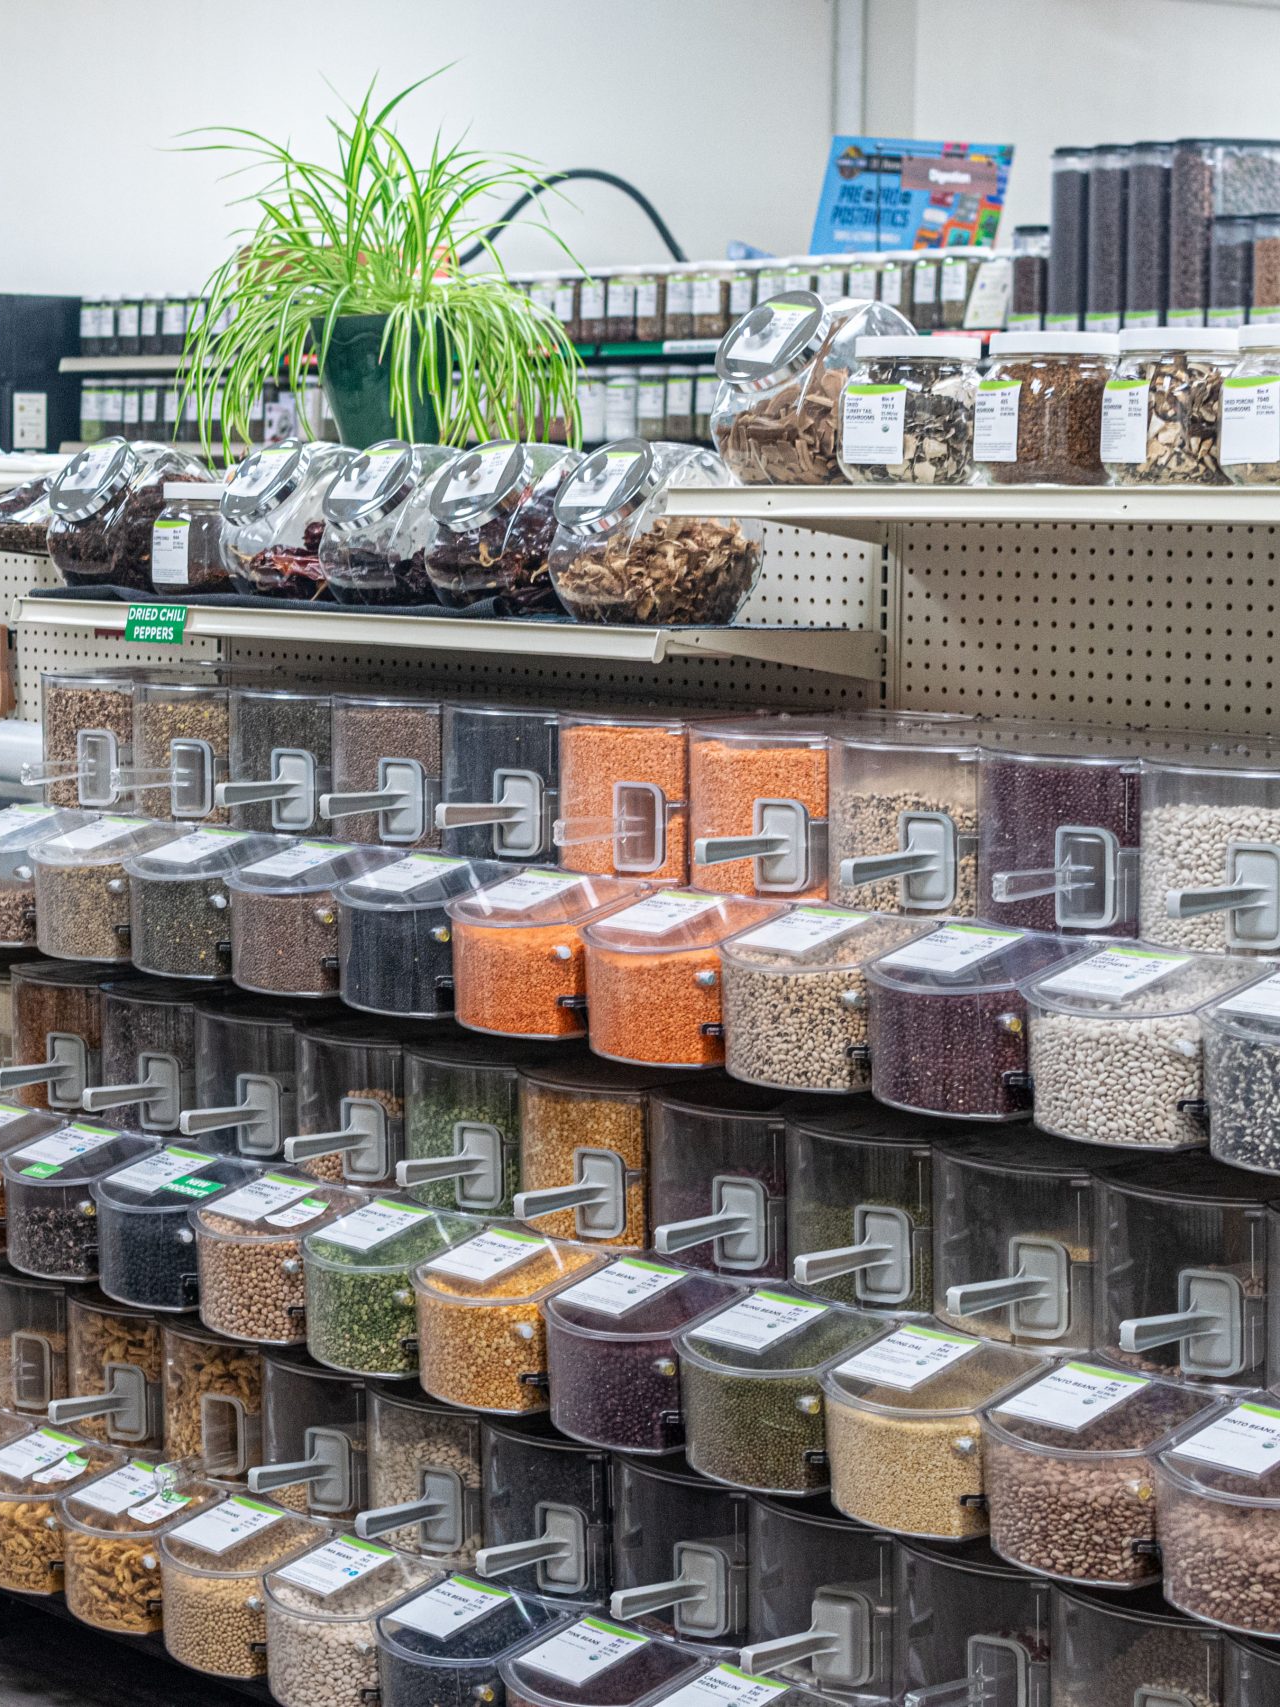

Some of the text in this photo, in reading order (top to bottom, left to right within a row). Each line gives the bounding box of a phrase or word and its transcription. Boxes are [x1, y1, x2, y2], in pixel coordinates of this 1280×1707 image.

[129, 608, 186, 622] DRIED CHILI
[134, 626, 174, 641] PEPPERS
[163, 1182, 210, 1197] PRODUCT
[186, 1178, 212, 1188] NEW
[617, 1273, 636, 1281] BEANS
[741, 1303, 761, 1312] MUNG
[761, 1307, 782, 1317] BEANS
[887, 1338, 907, 1347] MUNG
[908, 1343, 923, 1351] DAL
[1048, 1376, 1072, 1385] PINTO
[1072, 1381, 1098, 1391] BEANS
[1223, 1417, 1276, 1434] PINTO BEANS
[336, 1552, 353, 1560] BEANS
[435, 1588, 451, 1597] BLACK
[451, 1594, 470, 1603] BEANS
[567, 1630, 580, 1639] PINK
[580, 1635, 601, 1645] BEANS
[698, 1680, 719, 1690] BEANS
[704, 1676, 742, 1691] CANNELLINI
